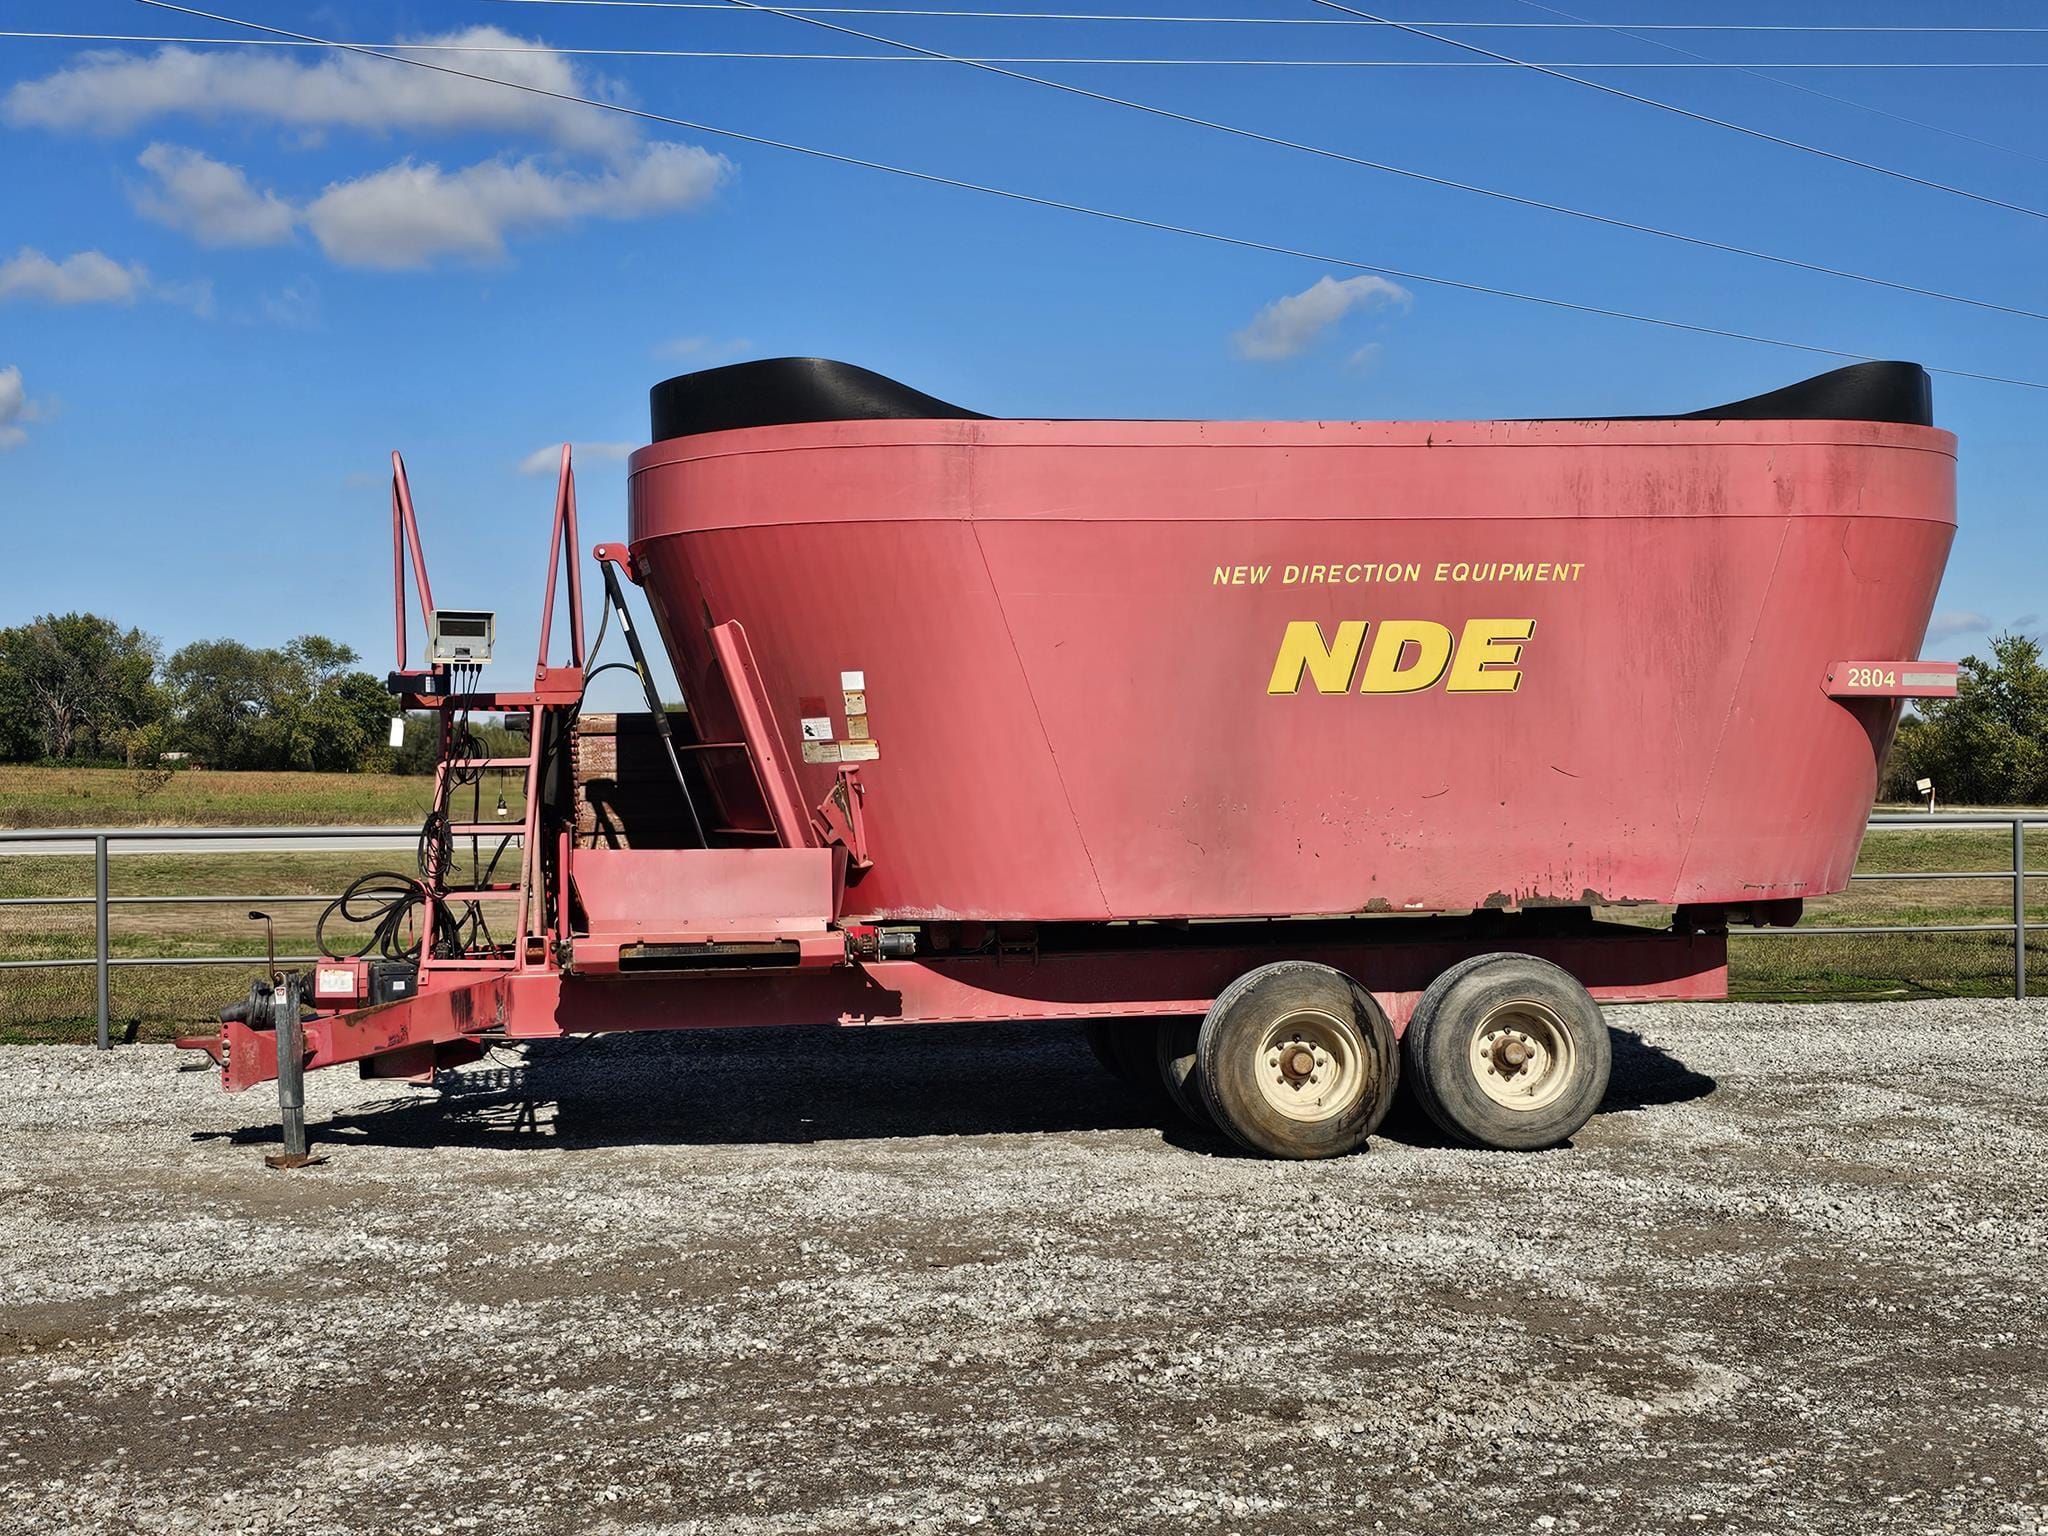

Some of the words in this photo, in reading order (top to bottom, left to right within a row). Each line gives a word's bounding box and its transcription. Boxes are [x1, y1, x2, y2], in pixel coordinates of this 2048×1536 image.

[1212, 565, 1272, 586] NEW
[1282, 563, 1422, 585] DIRECTION
[1433, 562, 1585, 582] EQUIPMENT
[1266, 618, 1537, 697] NDE
[1847, 667, 1897, 689] 2804
